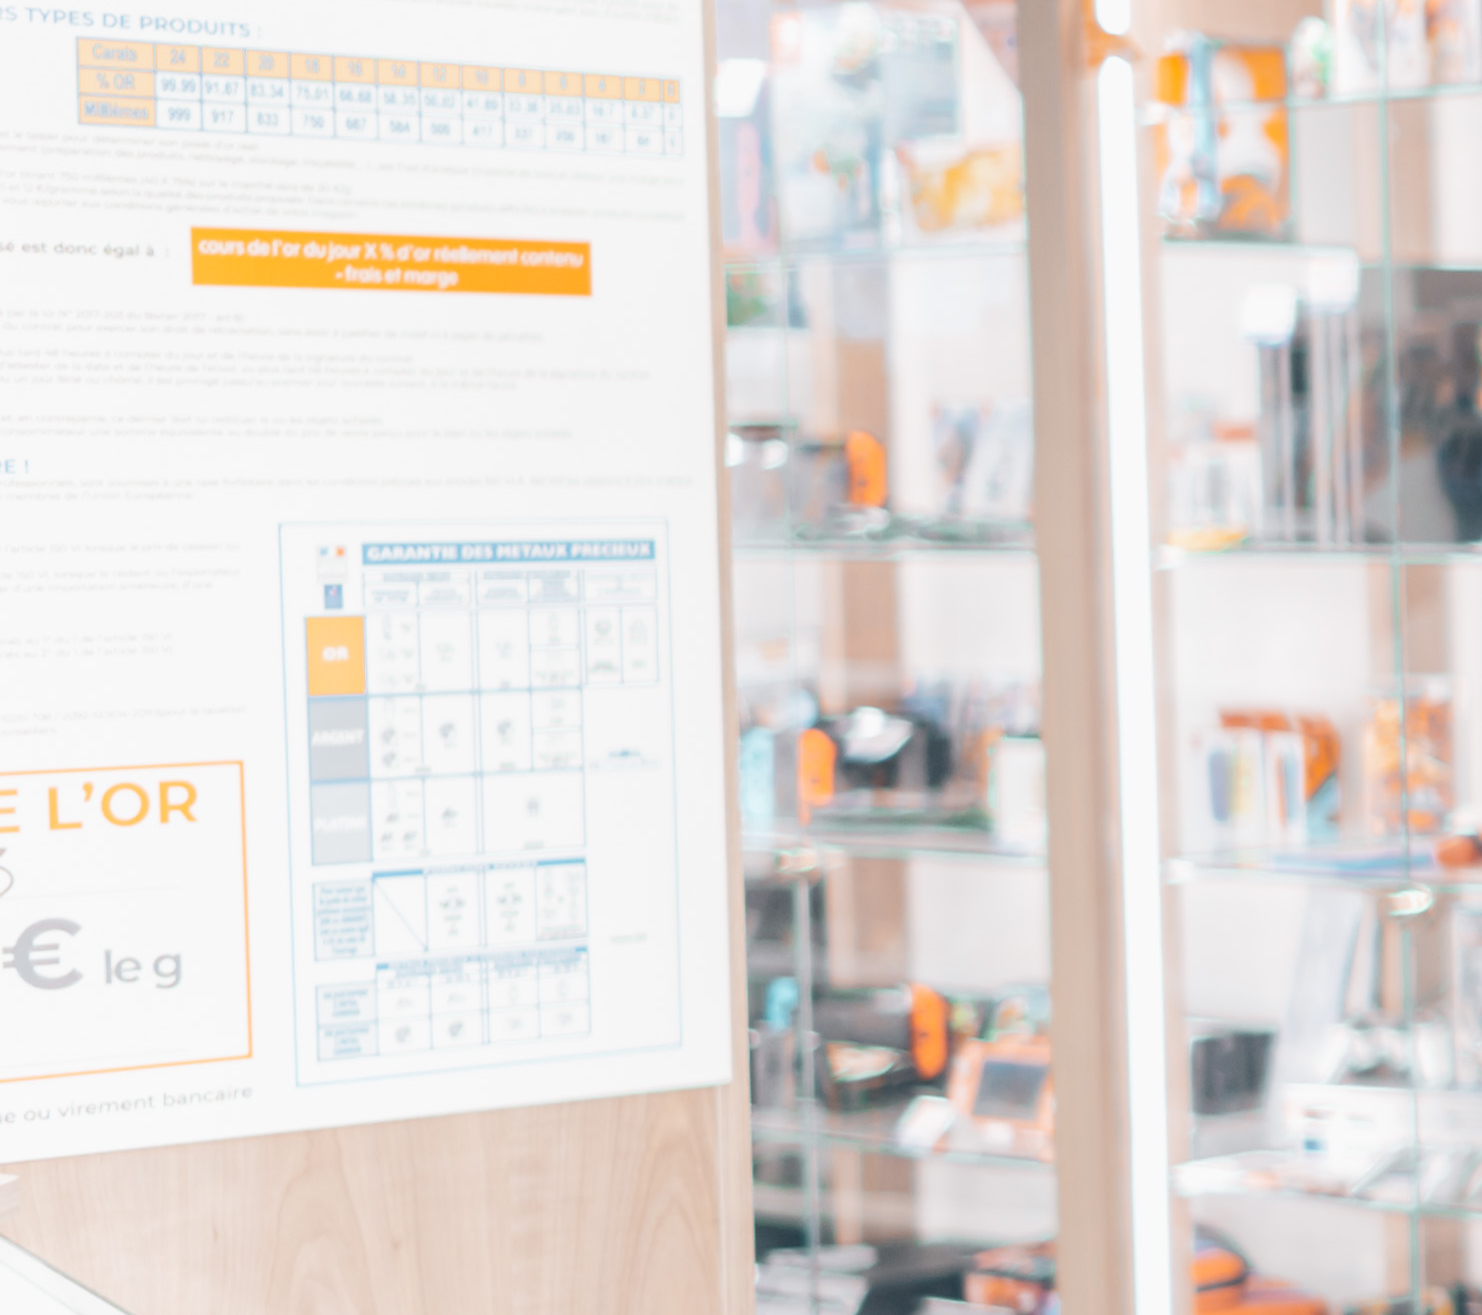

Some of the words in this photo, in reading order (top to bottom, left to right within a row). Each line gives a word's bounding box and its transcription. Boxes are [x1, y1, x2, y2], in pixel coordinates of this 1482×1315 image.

[25, 8, 94, 27] TYPES
[102, 13, 131, 29] DE
[139, 15, 251, 37] PRODUITS
[21, 243, 48, 255] est
[54, 242, 97, 256] donc
[104, 244, 141, 259] égal
[199, 239, 245, 257] cours
[247, 239, 271, 256] de
[303, 241, 327, 258] du
[328, 243, 361, 262] jour
[364, 245, 377, 259] X
[521, 249, 584, 267] contenu
[346, 266, 381, 284] frais
[385, 268, 401, 284] et
[404, 269, 458, 289] marge
[366, 542, 458, 562] GARANTIE
[461, 542, 495, 561] DES
[497, 541, 566, 560] METAUX
[569, 541, 652, 559] PRECIEUX
[321, 645, 350, 662] OR
[310, 729, 366, 746] ARGENT
[47, 779, 200, 831] L'OR
[103, 950, 141, 984] le
[153, 953, 183, 989] g
[24, 1106, 51, 1122] ou
[57, 1095, 156, 1120] virement
[162, 1084, 253, 1108] bancaire
